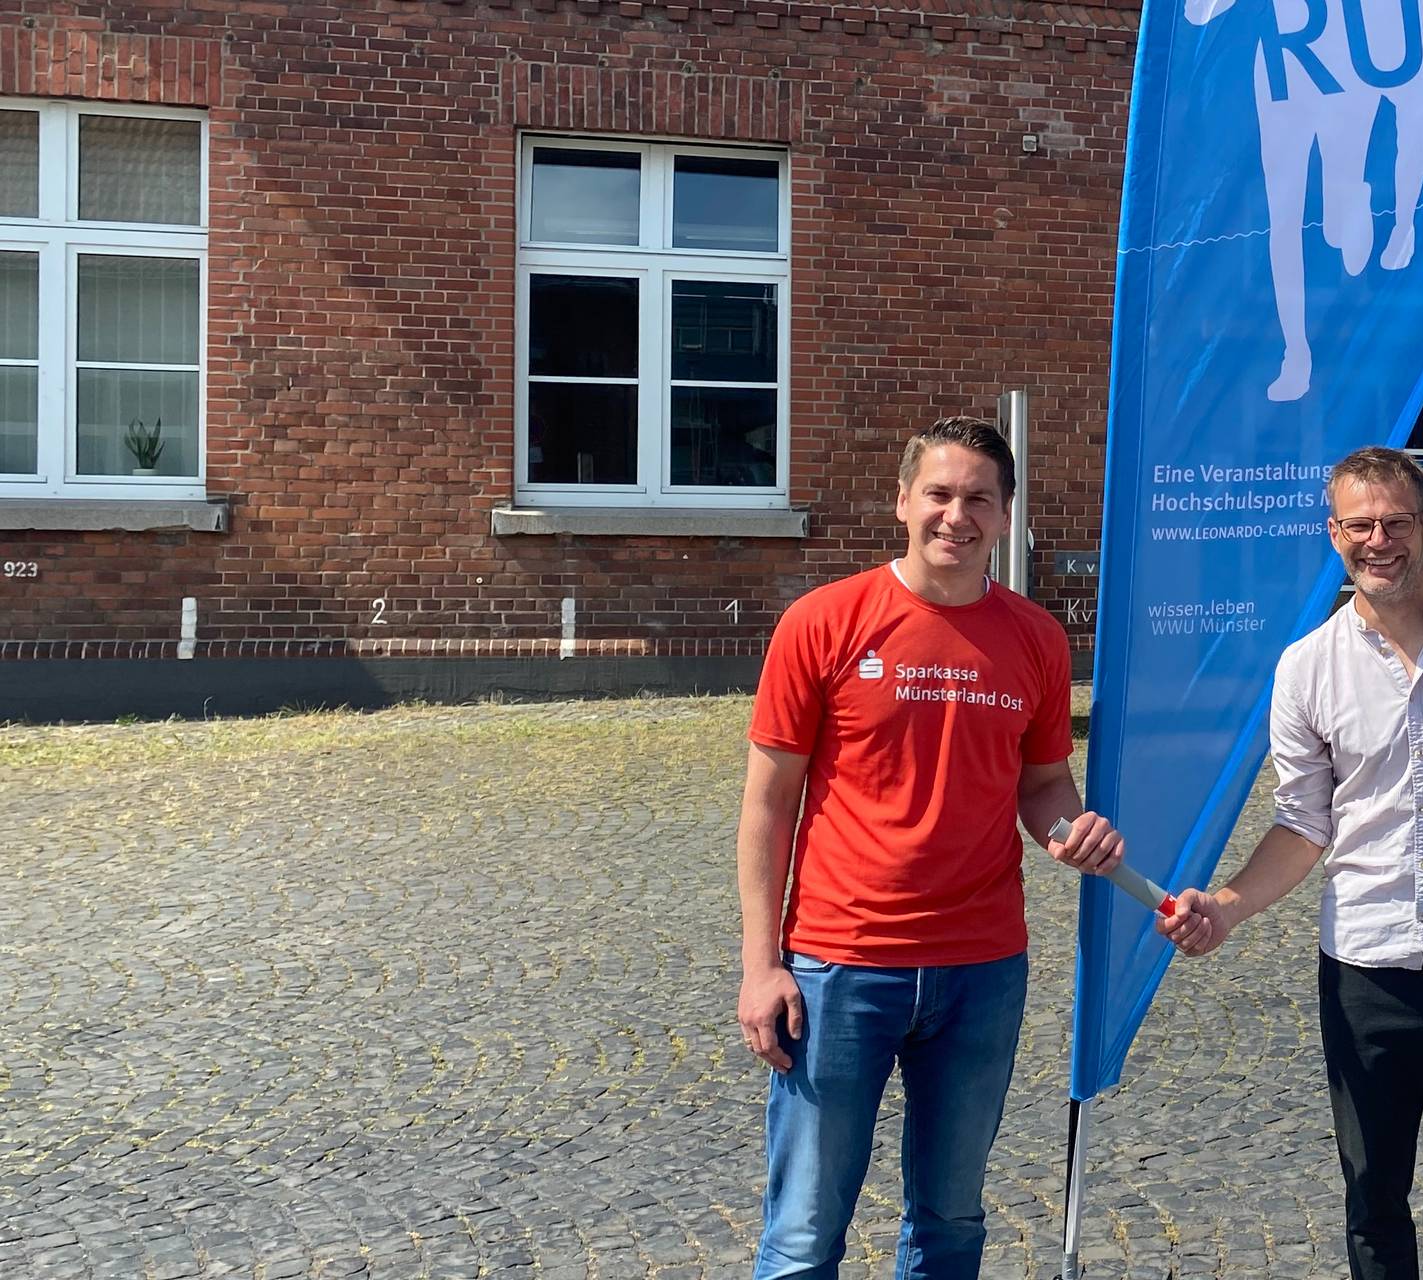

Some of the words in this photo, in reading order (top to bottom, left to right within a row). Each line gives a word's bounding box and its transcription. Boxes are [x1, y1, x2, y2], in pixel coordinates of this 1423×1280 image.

[1153, 464, 1195, 483] Eine
[1200, 462, 1332, 483] Veranstaltung
[1152, 490, 1315, 513] Hochschulsports
[1152, 522, 1329, 539] WWW.LEONARDO-CAMPUS-
[4, 561, 38, 577] 923
[371, 598, 388, 625] 2
[724, 599, 738, 625] 1
[1148, 599, 1255, 617] wissen.leben
[1151, 619, 1194, 636] WWU
[1200, 617, 1266, 634] Münster
[895, 663, 978, 682] Sparkasse
[895, 686, 996, 706] Münsterland
[1000, 694, 1024, 712] Ost
